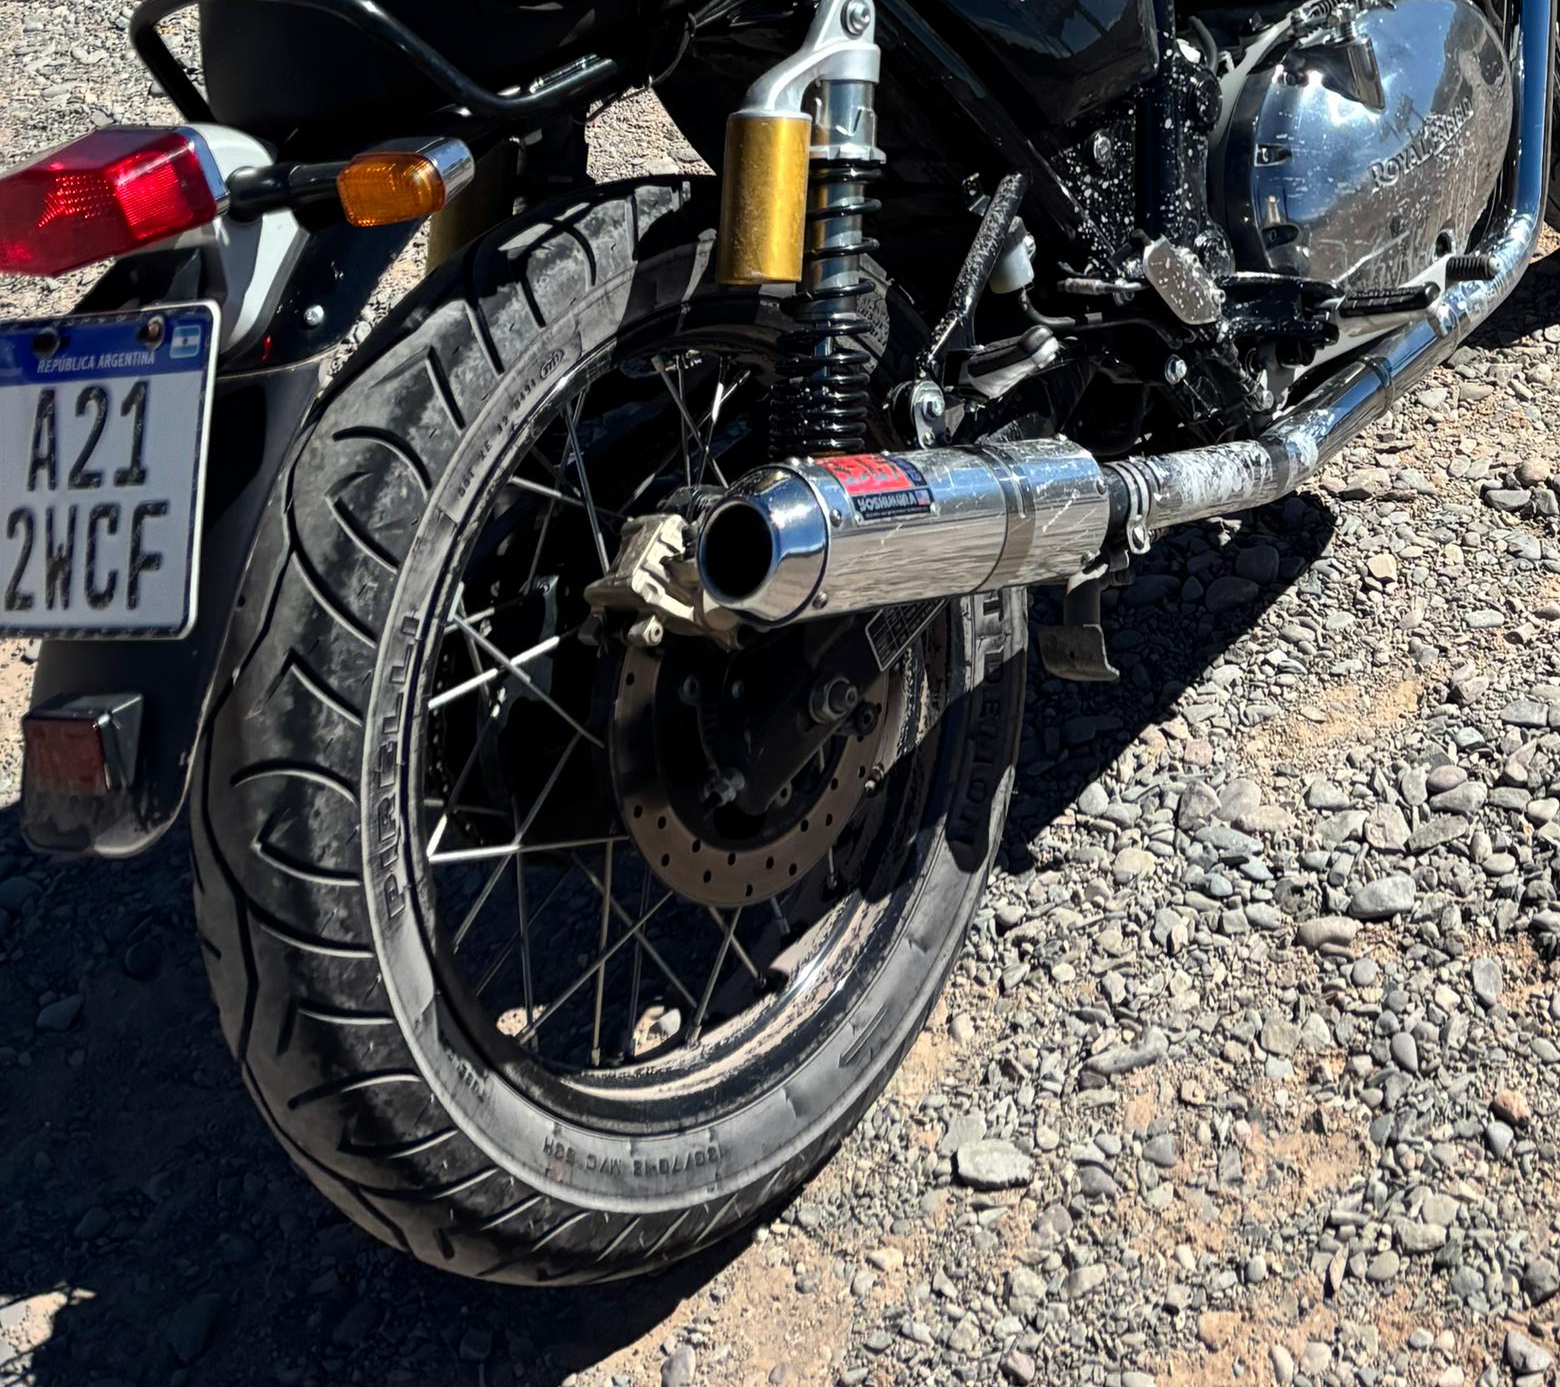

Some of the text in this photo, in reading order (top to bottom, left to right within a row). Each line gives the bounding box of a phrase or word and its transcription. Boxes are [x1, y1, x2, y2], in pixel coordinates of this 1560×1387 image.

[1370, 138, 1433, 194] ROYAL
[37, 351, 156, 374] REPÚBLICA ARGENTINA
[27, 381, 148, 492] A21
[857, 491, 917, 512] YOSHIMURA
[4, 499, 170, 612] 2WCF
[377, 615, 420, 919] PIRELLI
